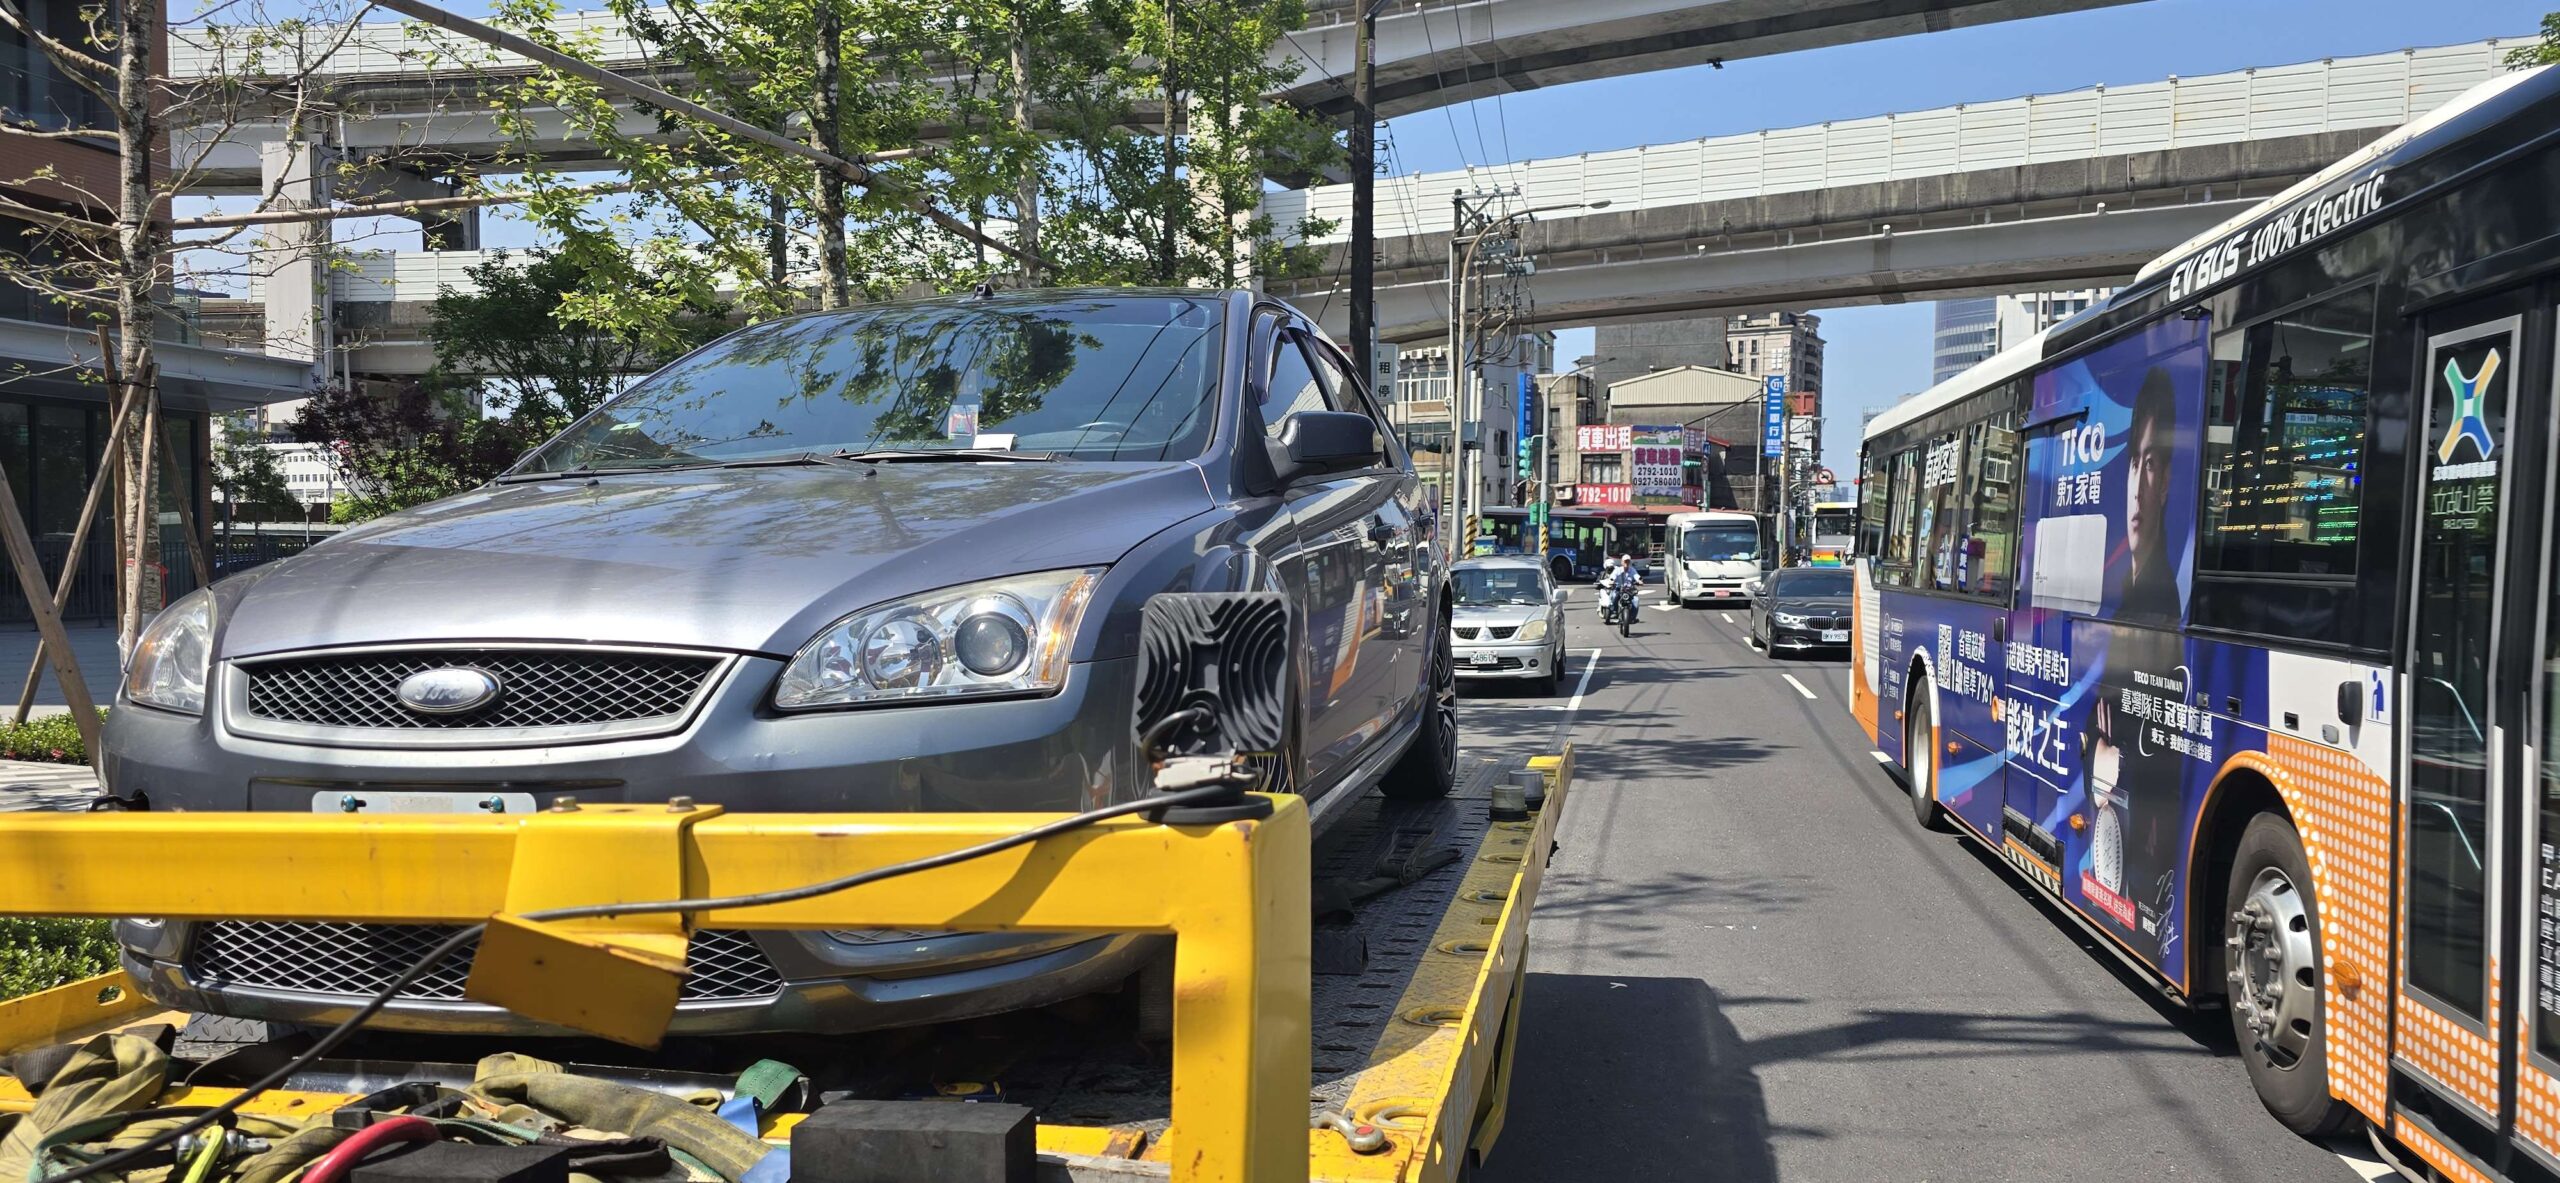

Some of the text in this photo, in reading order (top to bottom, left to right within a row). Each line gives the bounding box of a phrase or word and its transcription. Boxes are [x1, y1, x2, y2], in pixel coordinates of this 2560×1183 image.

[2196, 231, 2249, 291] BUS
[2247, 208, 2302, 267] 100%
[2300, 169, 2385, 243] Electric
[1577, 426, 1631, 451] 貨車出租
[1637, 467, 1678, 476] 2792-1010
[1577, 487, 1632, 504] 2792-1010
[2133, 670, 2183, 693] TECO TEAM TAIWAN
[2006, 697, 2069, 776] 能效之王
